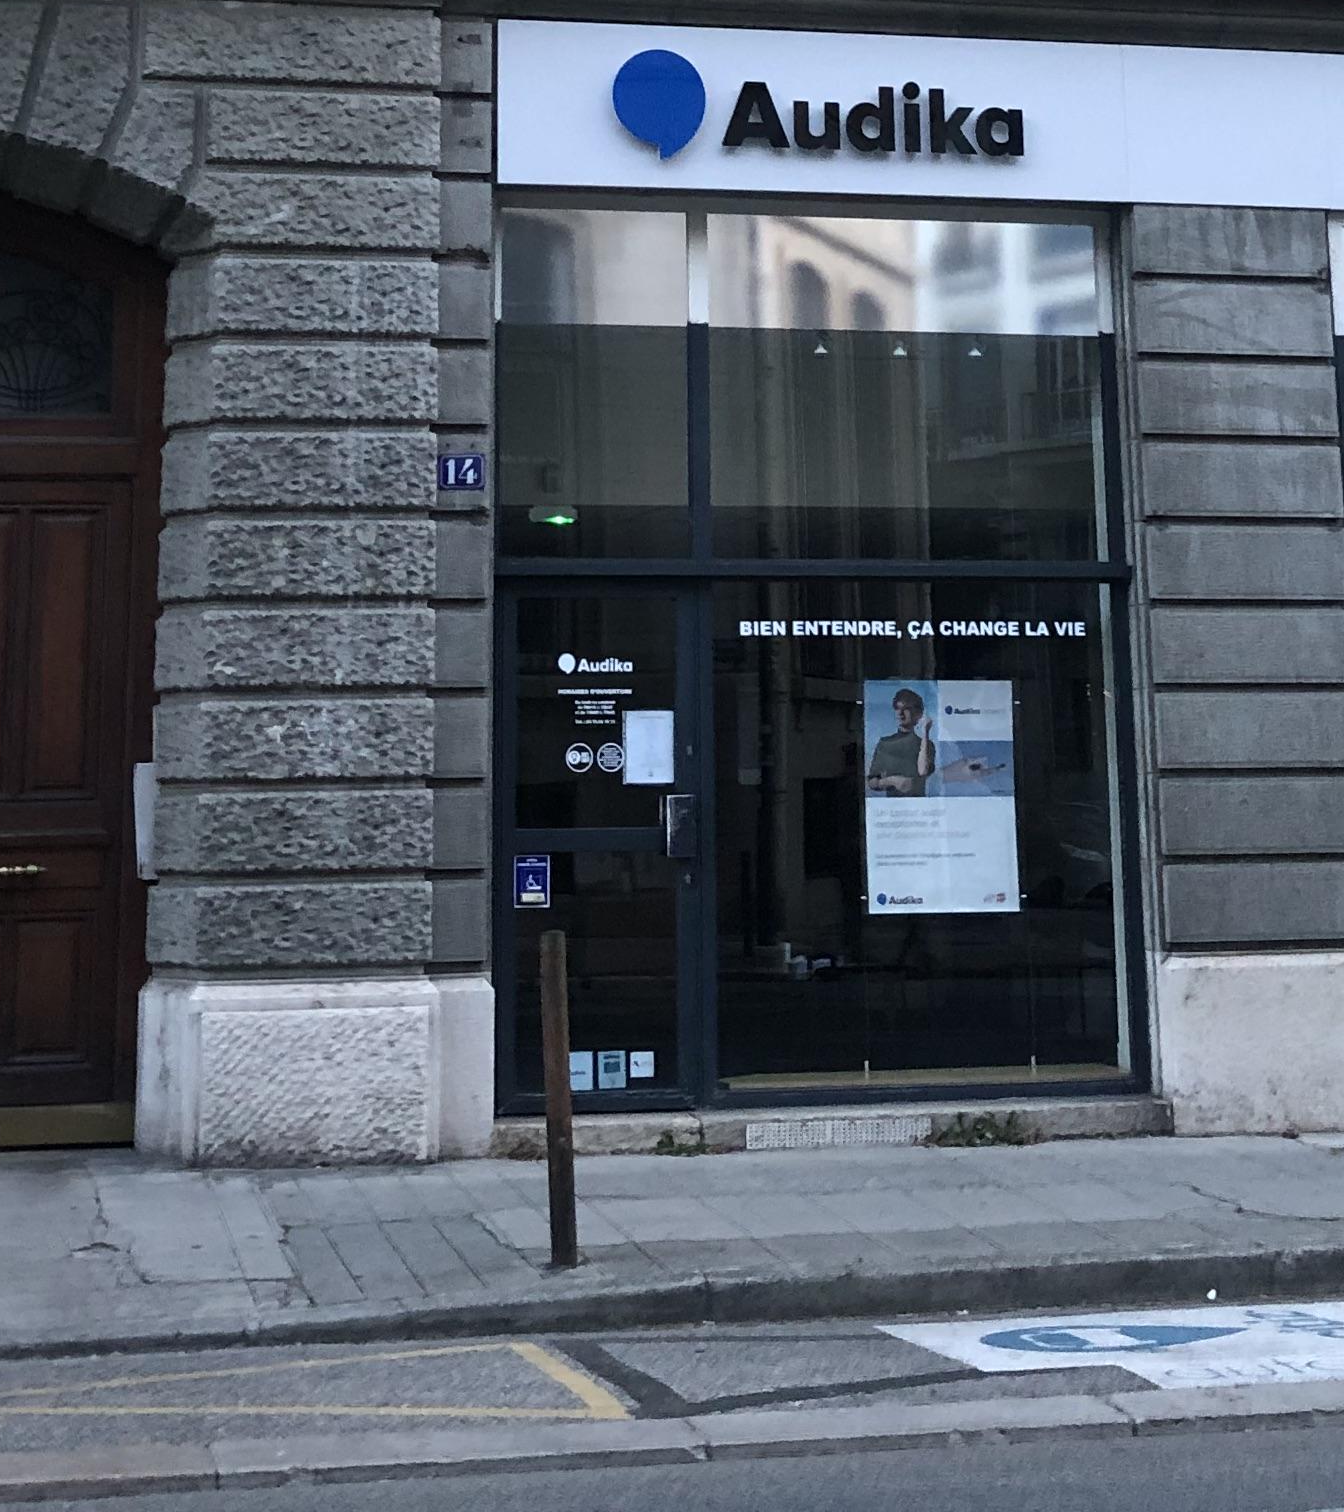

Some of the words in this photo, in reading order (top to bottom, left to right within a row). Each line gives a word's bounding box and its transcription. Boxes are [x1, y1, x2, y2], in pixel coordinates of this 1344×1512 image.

[721, 81, 1025, 157] Audika
[445, 458, 478, 485] 14
[739, 620, 786, 637] BIEN
[792, 620, 903, 639] ENTENDRE,
[907, 620, 935, 640] ÇA
[939, 620, 1020, 637] CHANGE
[1024, 621, 1050, 637] LA
[1053, 621, 1087, 637] VIE
[577, 657, 634, 673] Audika
